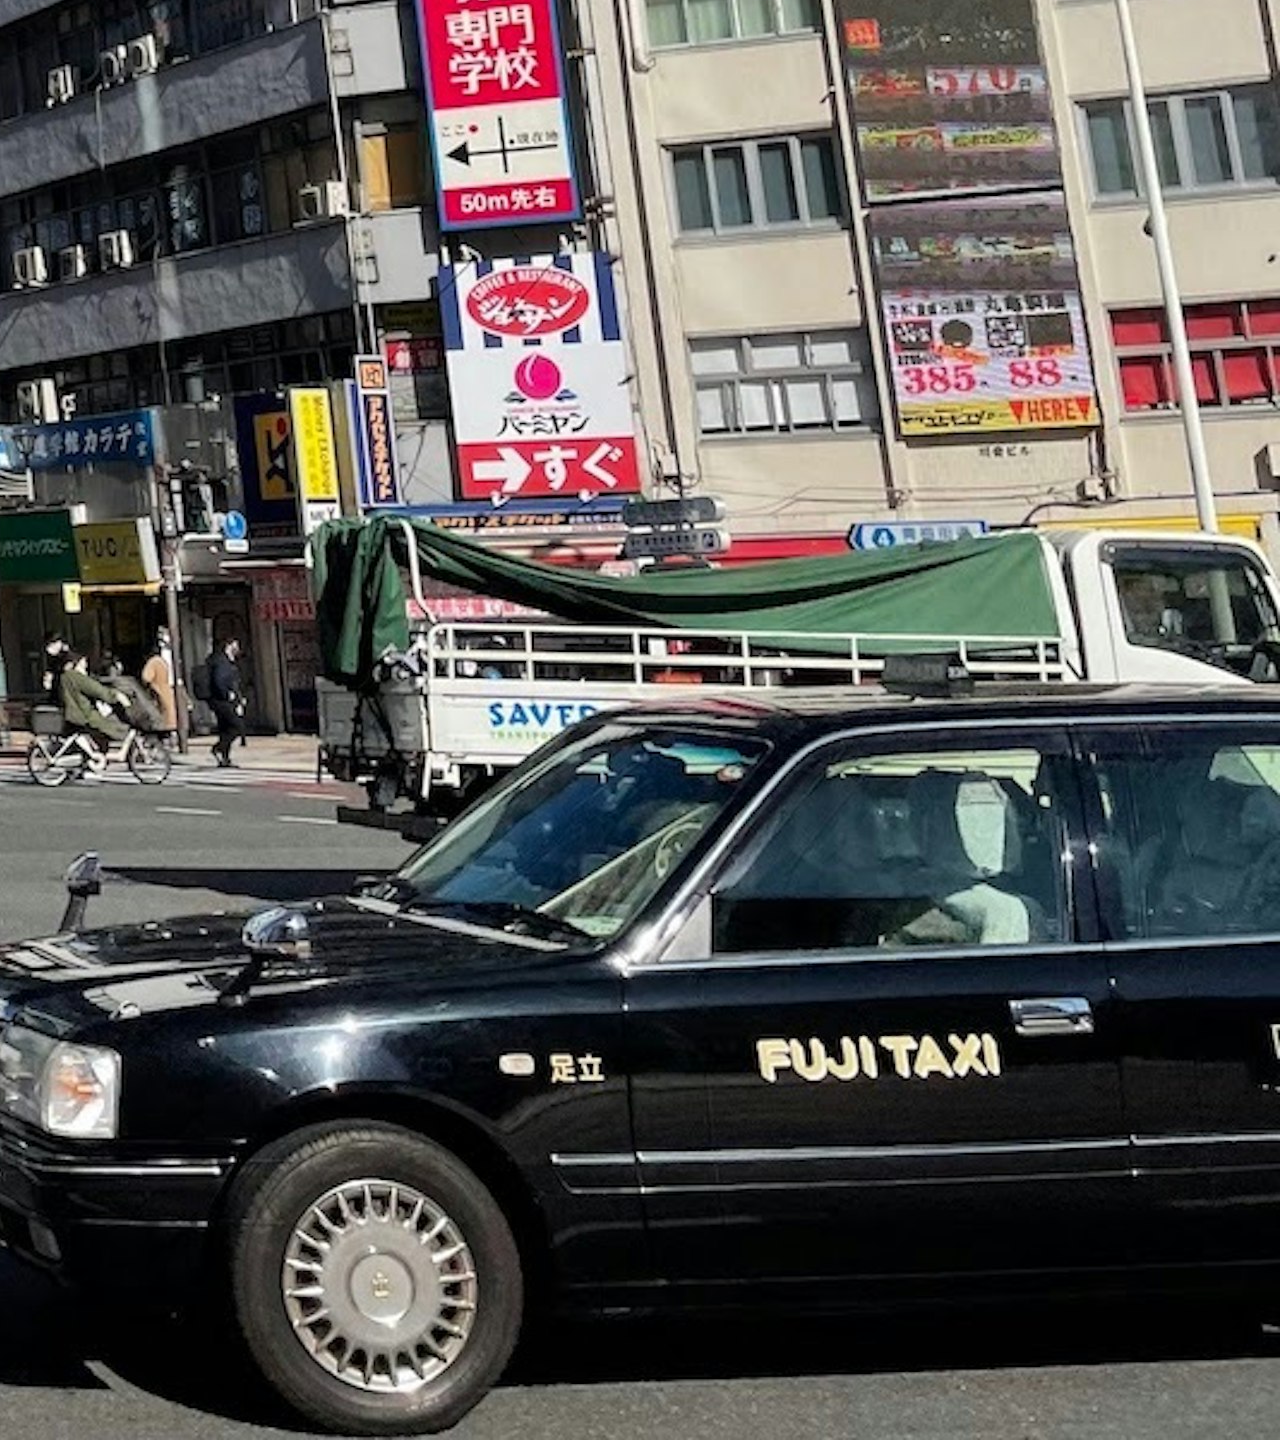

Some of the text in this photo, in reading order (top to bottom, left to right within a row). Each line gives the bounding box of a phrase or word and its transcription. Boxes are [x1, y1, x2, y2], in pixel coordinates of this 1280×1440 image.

[444, 4, 536, 50] 専門
[449, 46, 541, 95] 学校
[459, 187, 557, 213] 50m先右
[496, 413, 591, 437] バーミヤン
[1027, 398, 1078, 422] HERE
[533, 441, 624, 492] すぐ
[549, 1033, 1002, 1083] 足立 FUJI TAXI
